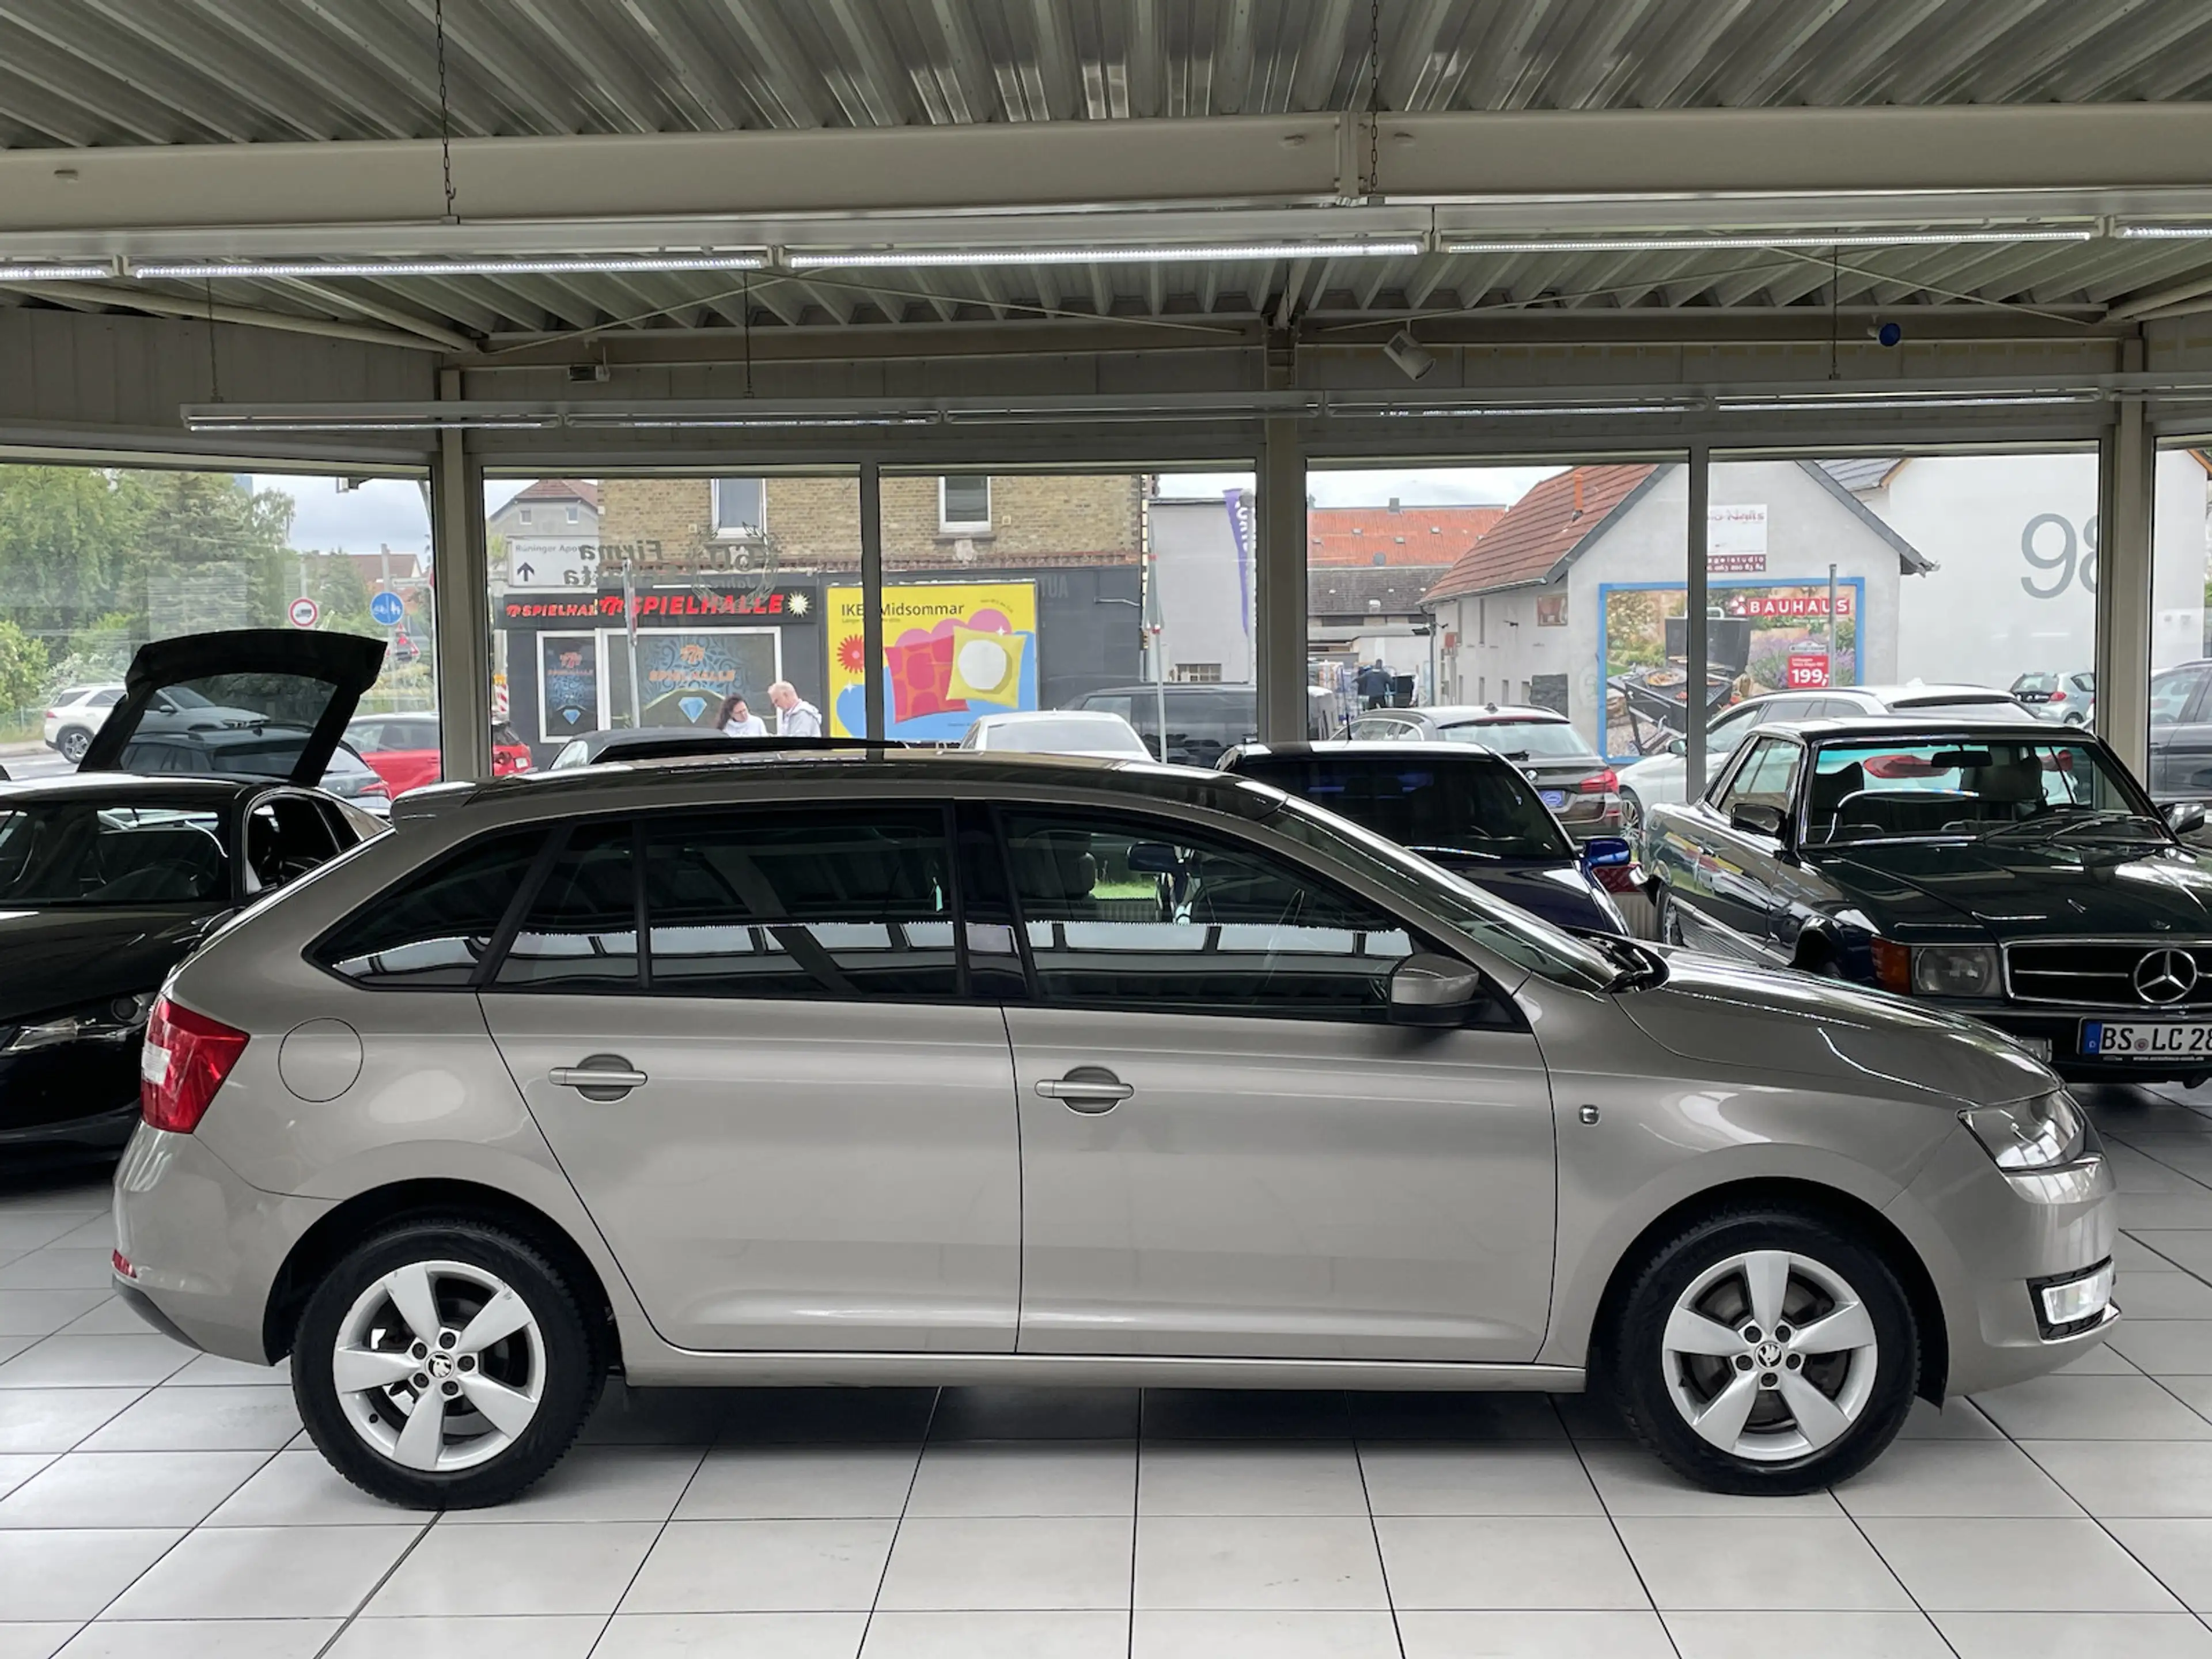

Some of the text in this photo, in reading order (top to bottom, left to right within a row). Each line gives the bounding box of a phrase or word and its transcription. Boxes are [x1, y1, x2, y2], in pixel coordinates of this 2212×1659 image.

[634, 594, 784, 615] SPIELHALLE
[842, 603, 965, 616] IKE Midsommar
[1750, 599, 1849, 613] BAUHAUS
[2101, 1027, 2134, 1050] BS
[2152, 1028, 2183, 1050] LC
